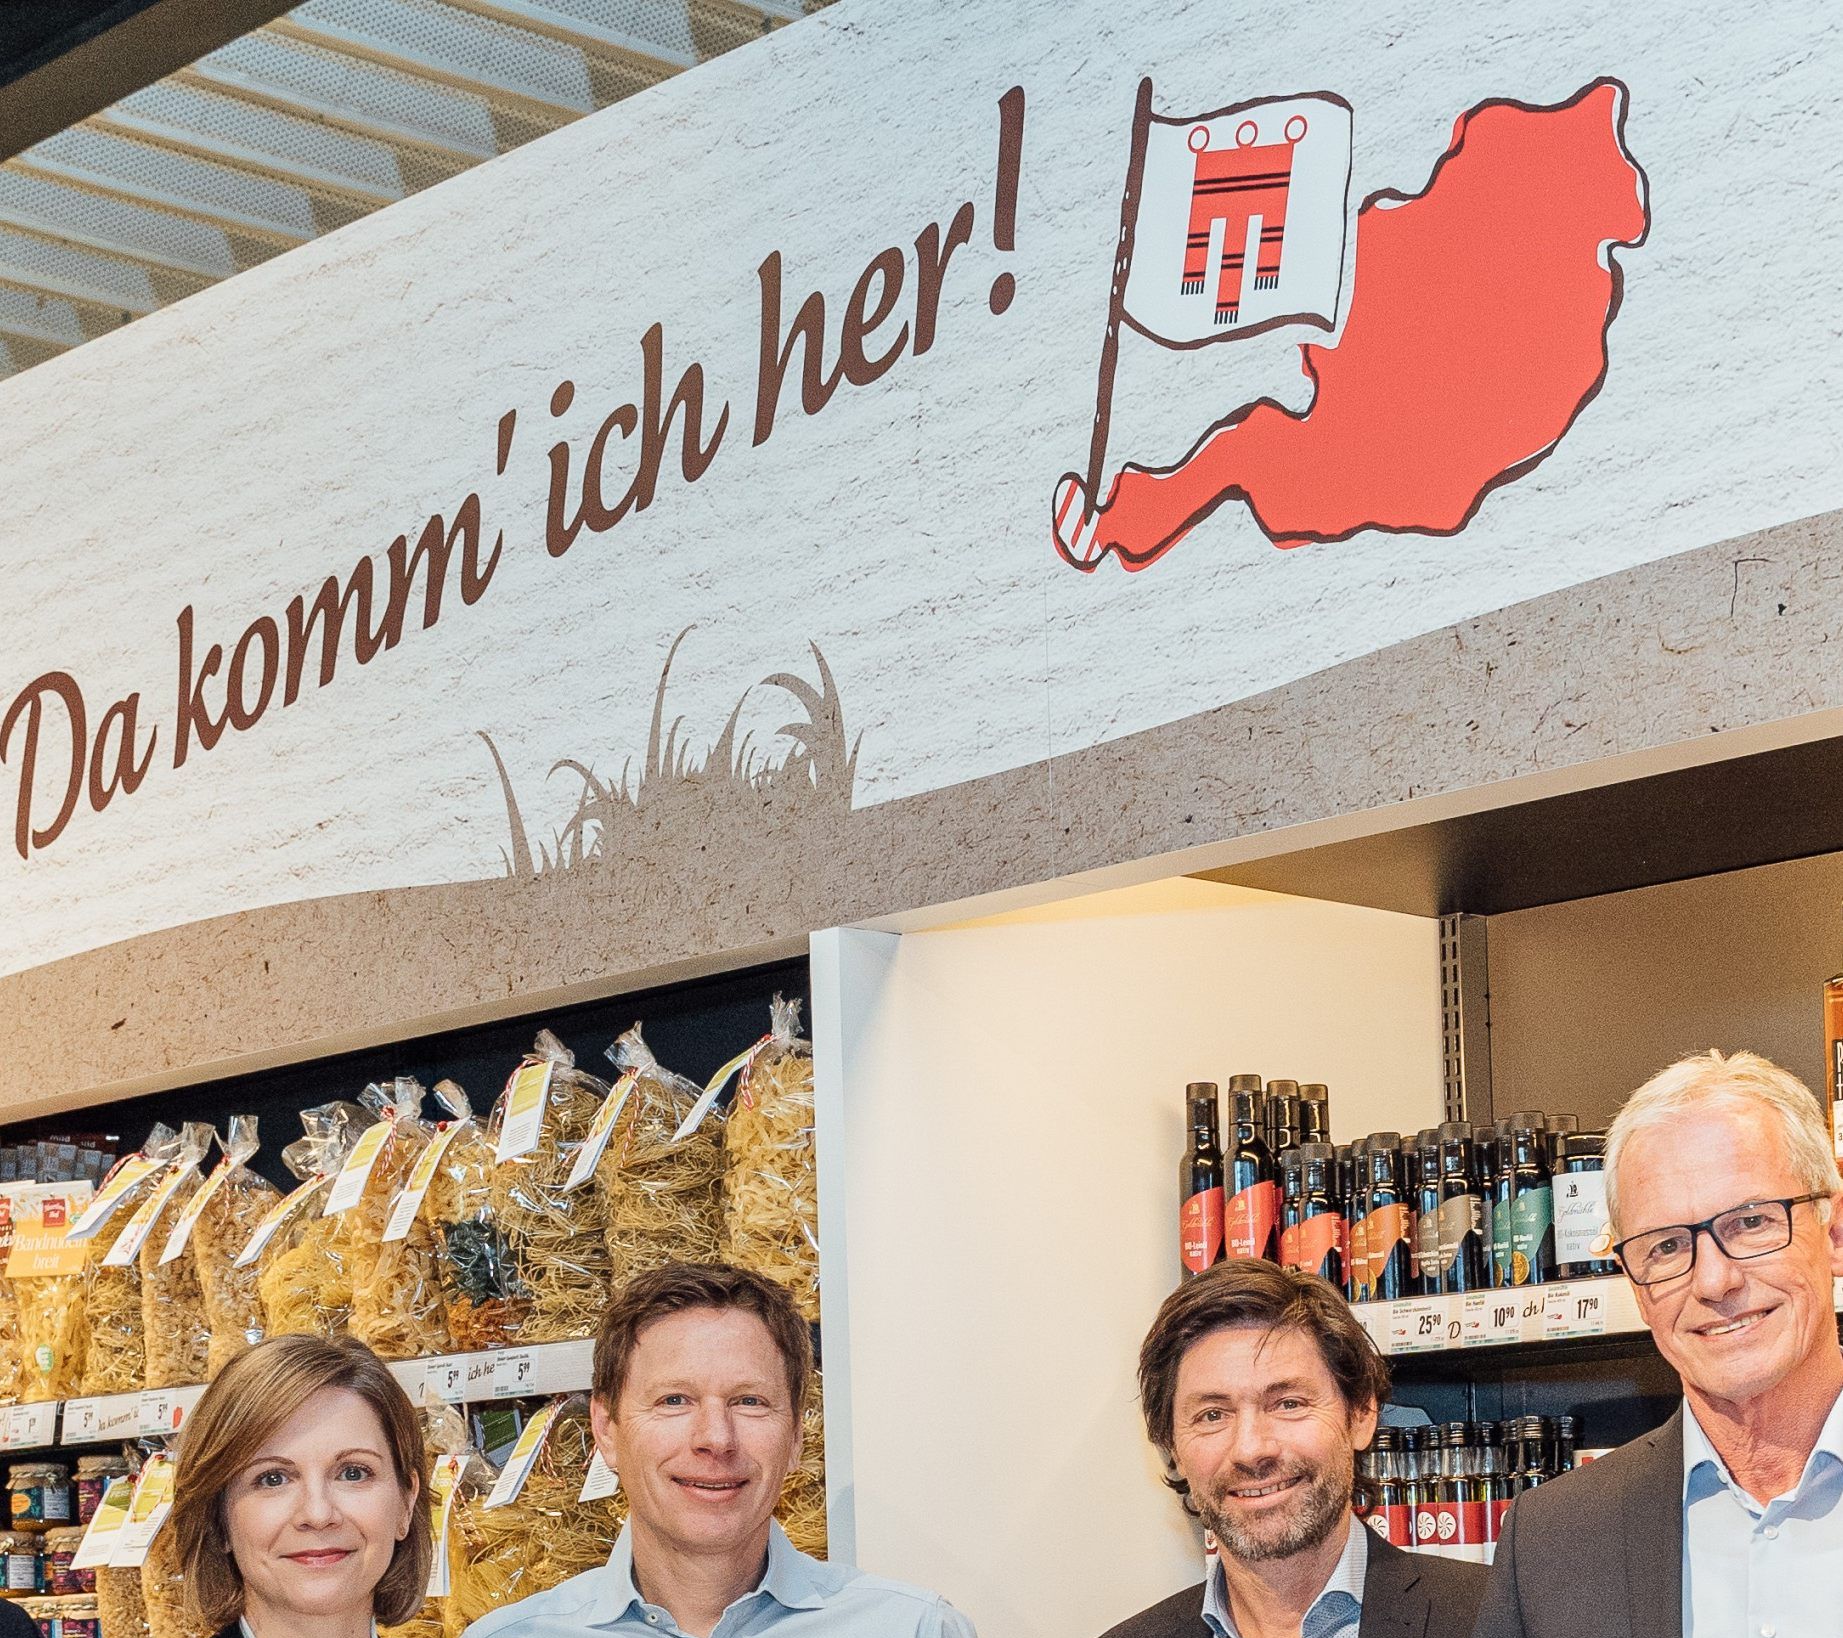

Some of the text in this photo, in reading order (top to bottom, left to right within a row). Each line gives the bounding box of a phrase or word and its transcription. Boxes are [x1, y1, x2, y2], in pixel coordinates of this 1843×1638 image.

[2, 85, 1025, 860] Da komm' ich her!
[483, 1361, 495, 1376] he
